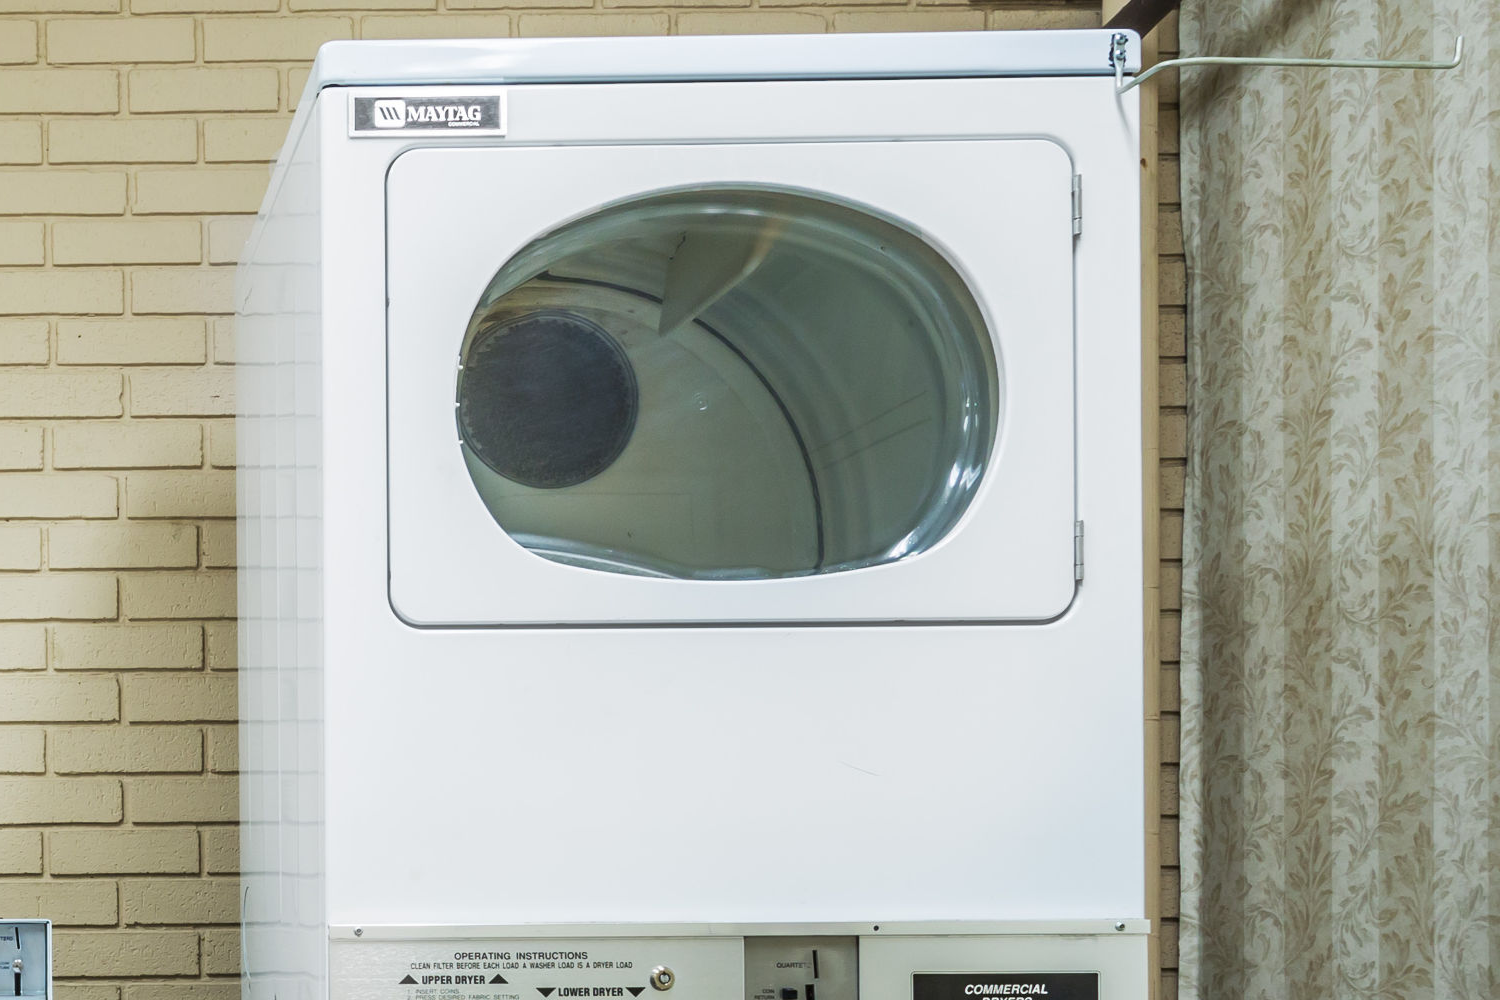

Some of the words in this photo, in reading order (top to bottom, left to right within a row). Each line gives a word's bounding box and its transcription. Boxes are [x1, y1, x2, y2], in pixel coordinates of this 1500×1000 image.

[407, 105, 481, 121] MAYTAG
[454, 952, 511, 960] OPERATING
[516, 952, 588, 960] INSTRUCTIONS
[411, 962, 430, 970] CLEAN
[433, 962, 454, 970] FILTER
[456, 962, 480, 970] BEFORE
[483, 962, 500, 970] EACH
[503, 962, 519, 970] LOAD
[522, 962, 527, 970] A
[530, 962, 555, 970] WASHER
[558, 962, 575, 970] LOAD
[577, 962, 583, 970] IS
[586, 962, 591, 970] A
[593, 962, 613, 970] DRYER
[616, 962, 633, 970] LOAD
[421, 975, 452, 985] UPPER
[455, 975, 486, 985] DRYER
[558, 987, 590, 997] LOWER
[593, 987, 624, 997] DRYER
[964, 984, 1048, 995] COMMERCIAL
